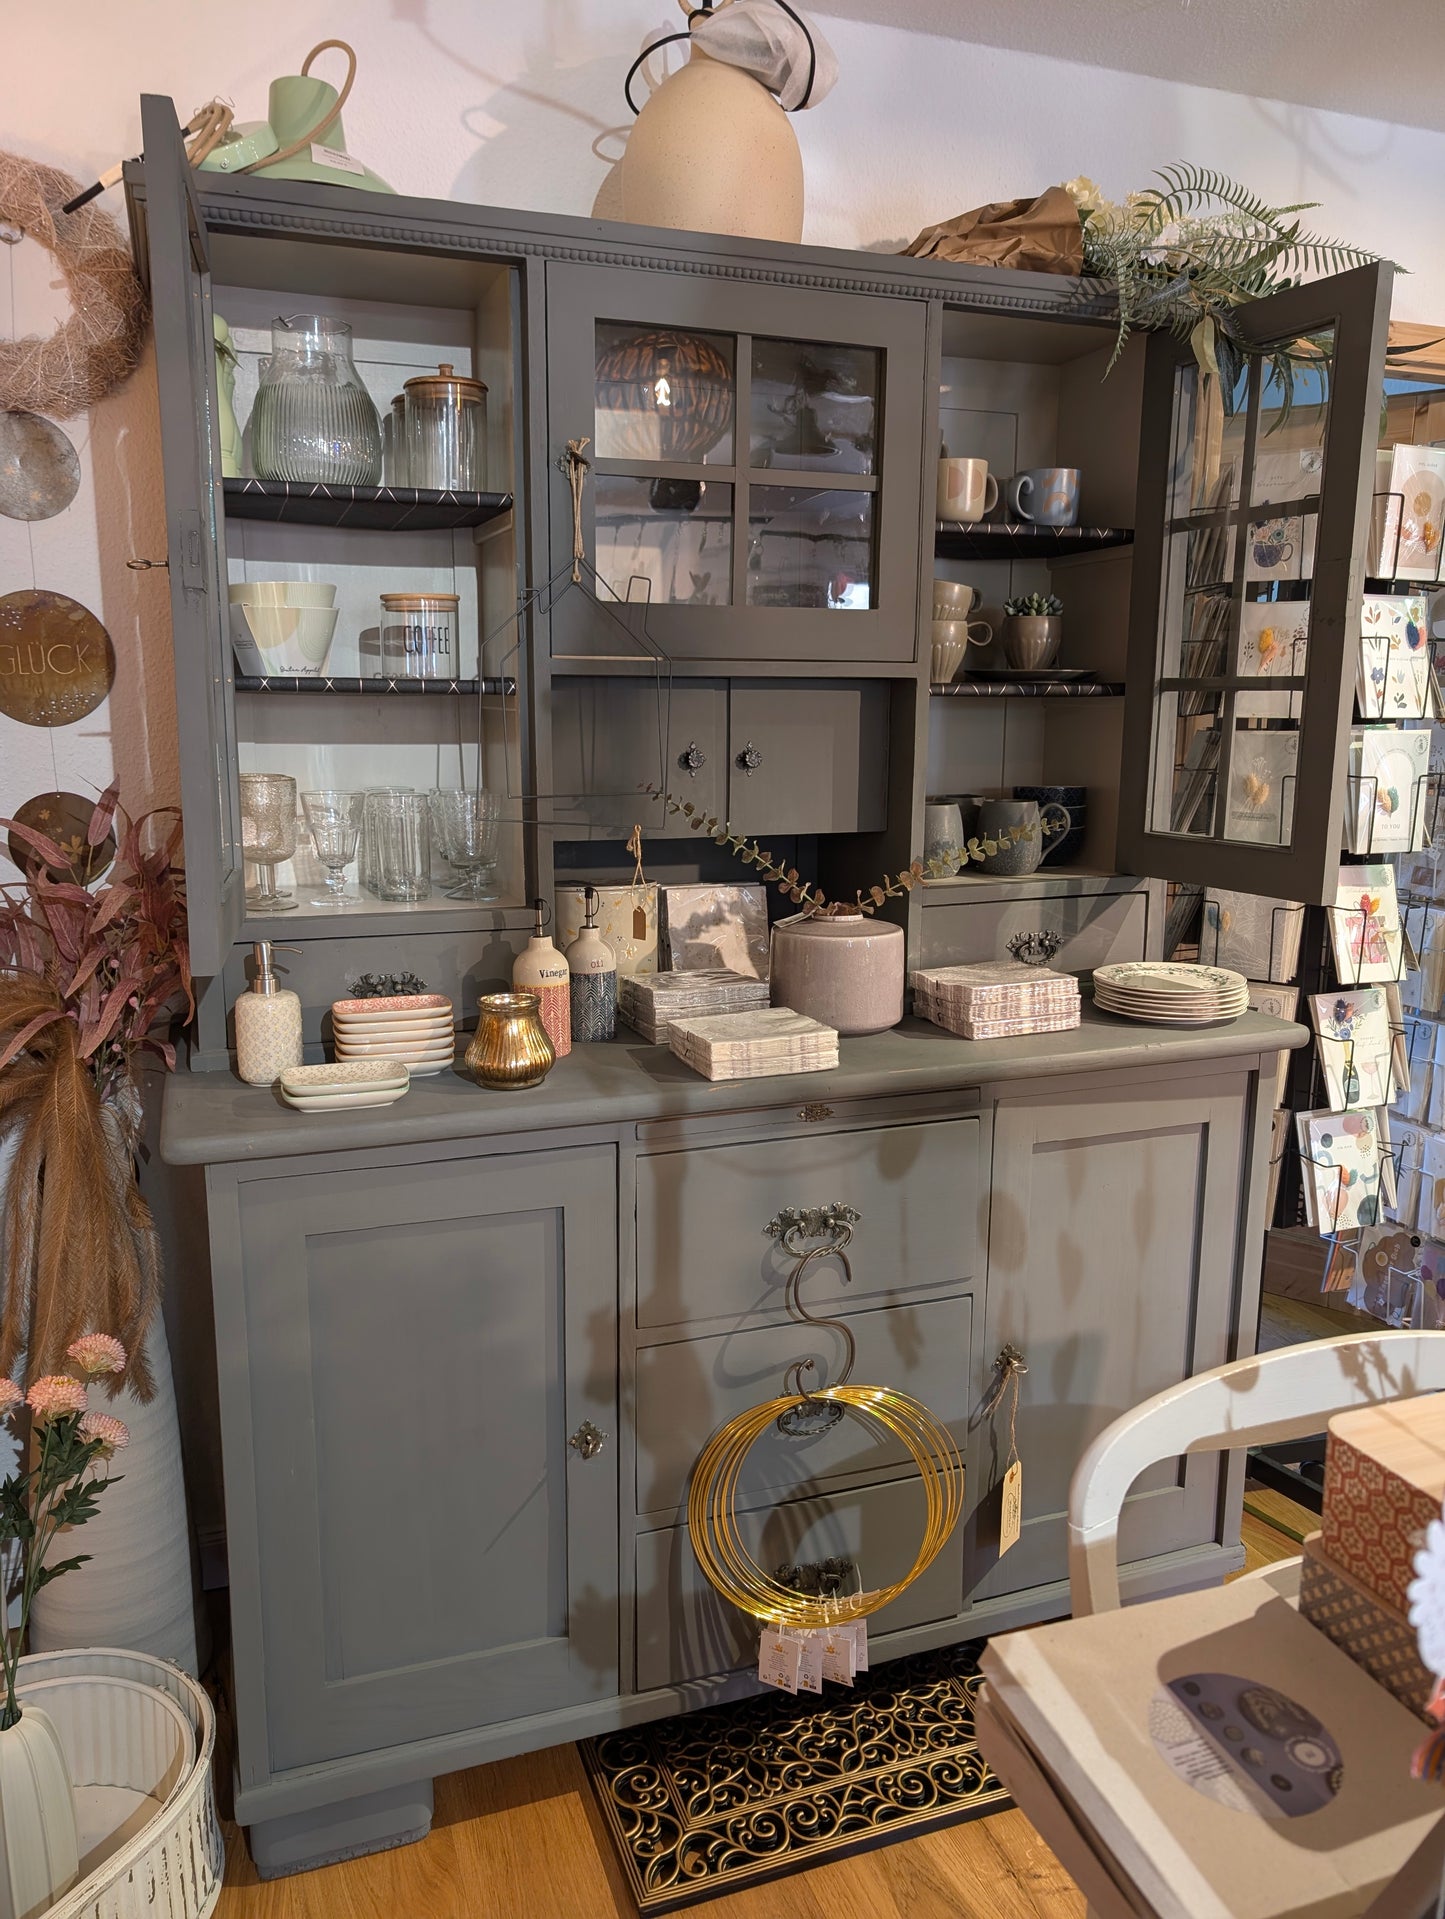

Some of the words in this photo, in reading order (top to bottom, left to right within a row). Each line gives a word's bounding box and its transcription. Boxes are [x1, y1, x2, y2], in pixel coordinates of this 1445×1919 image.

[403, 625, 450, 655] COFFEE
[0, 641, 93, 676] GLÜCK
[539, 968, 568, 978] Vinegar
[590, 960, 604, 968] Oil
